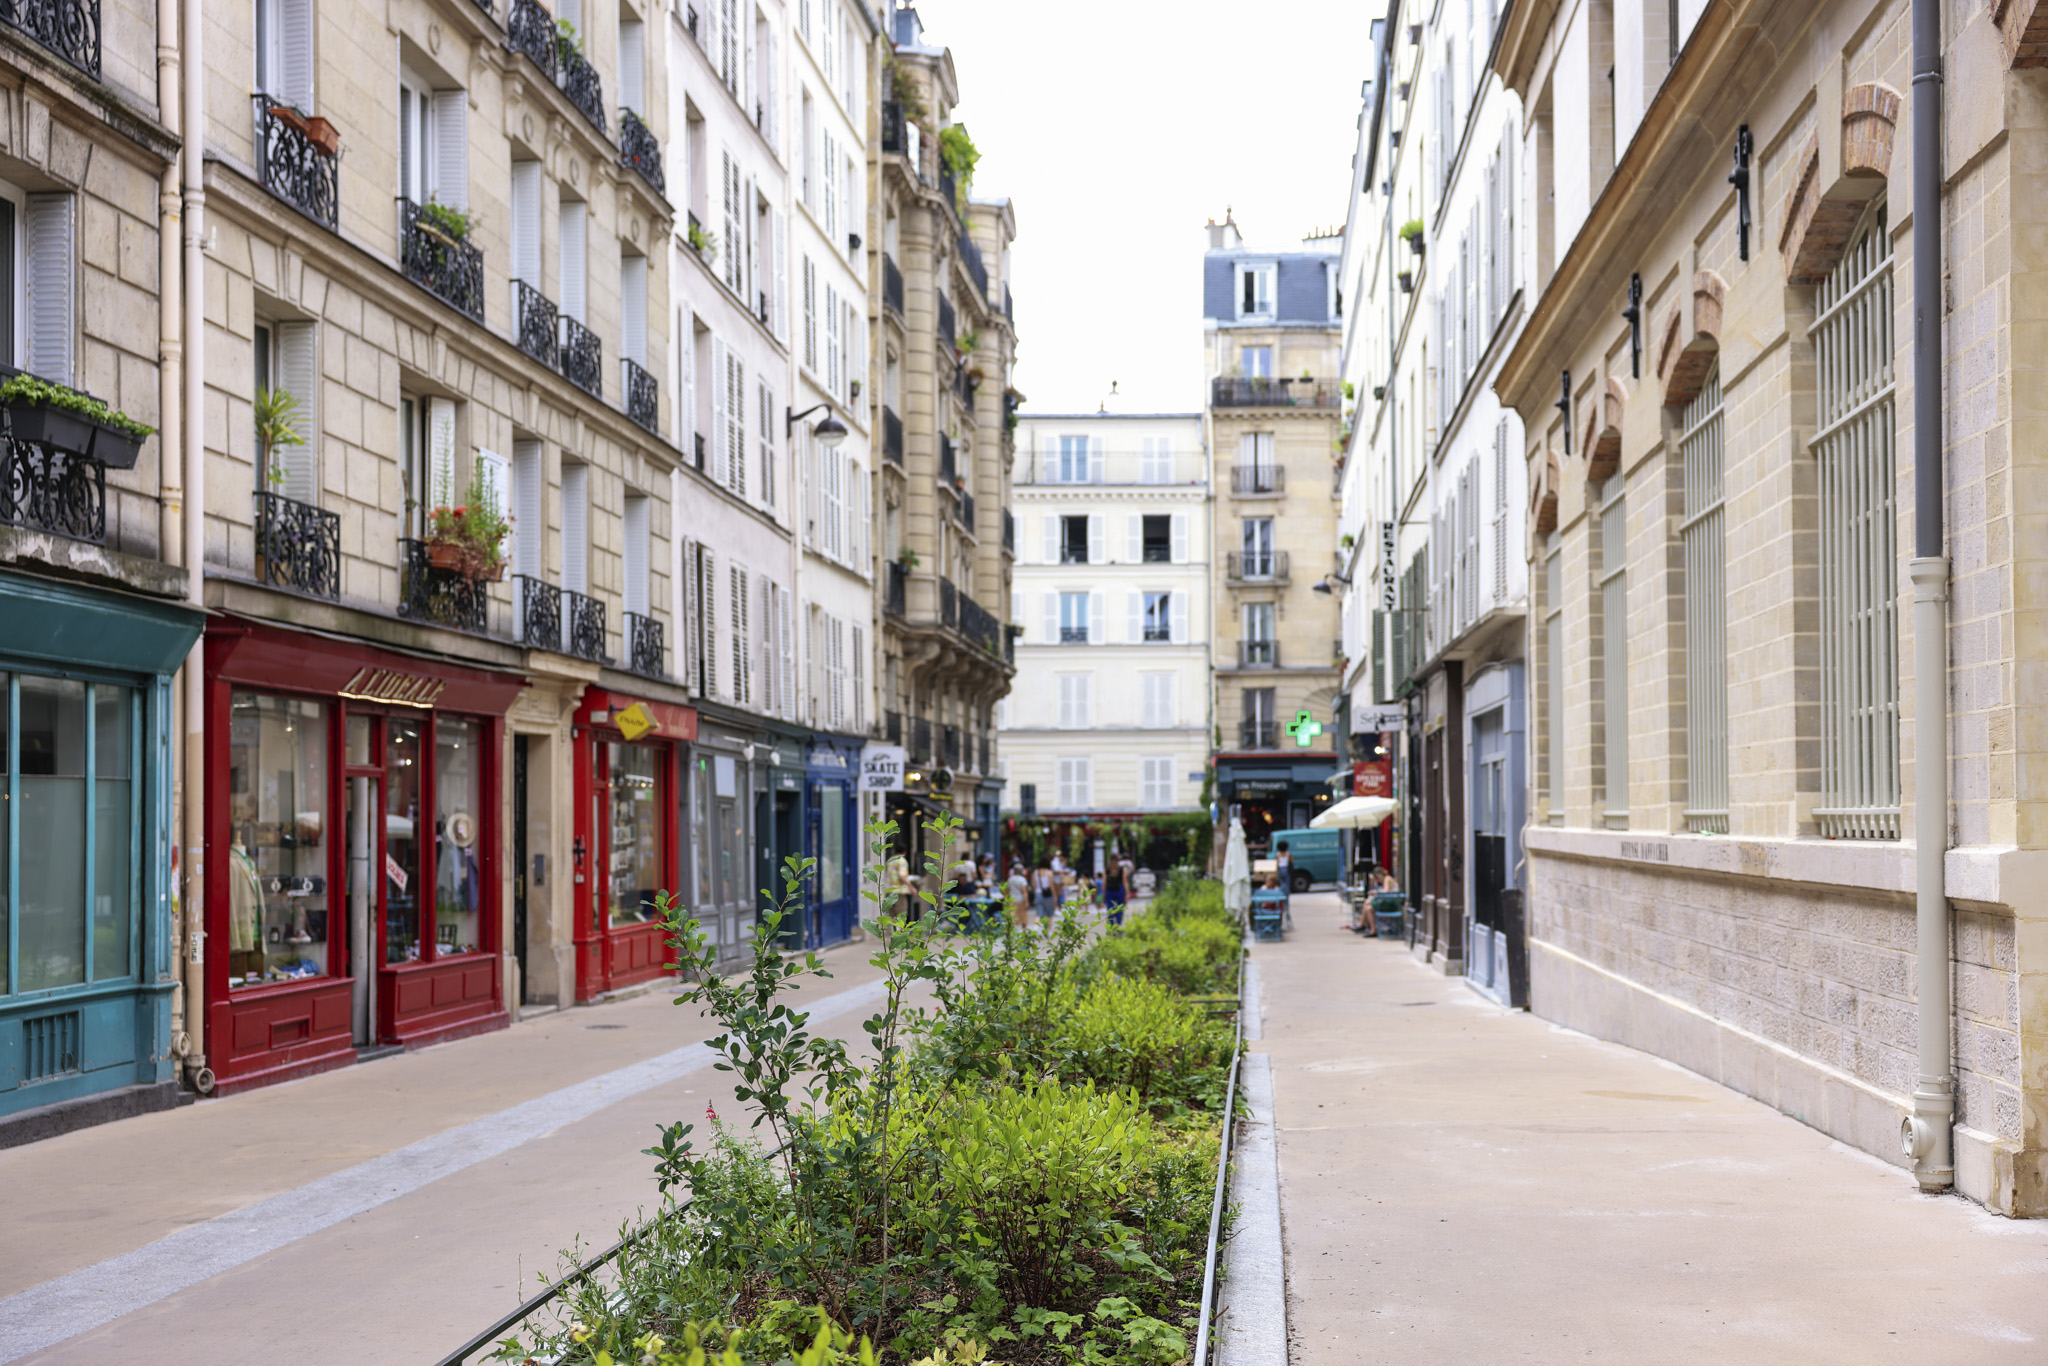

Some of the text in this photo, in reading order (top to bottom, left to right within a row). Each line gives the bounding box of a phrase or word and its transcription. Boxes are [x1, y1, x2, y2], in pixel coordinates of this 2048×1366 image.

[1383, 522, 1396, 611] RESTAURANT
[343, 667, 366, 692] A
[864, 762, 900, 774] SKATE
[868, 776, 895, 788] SHOP
